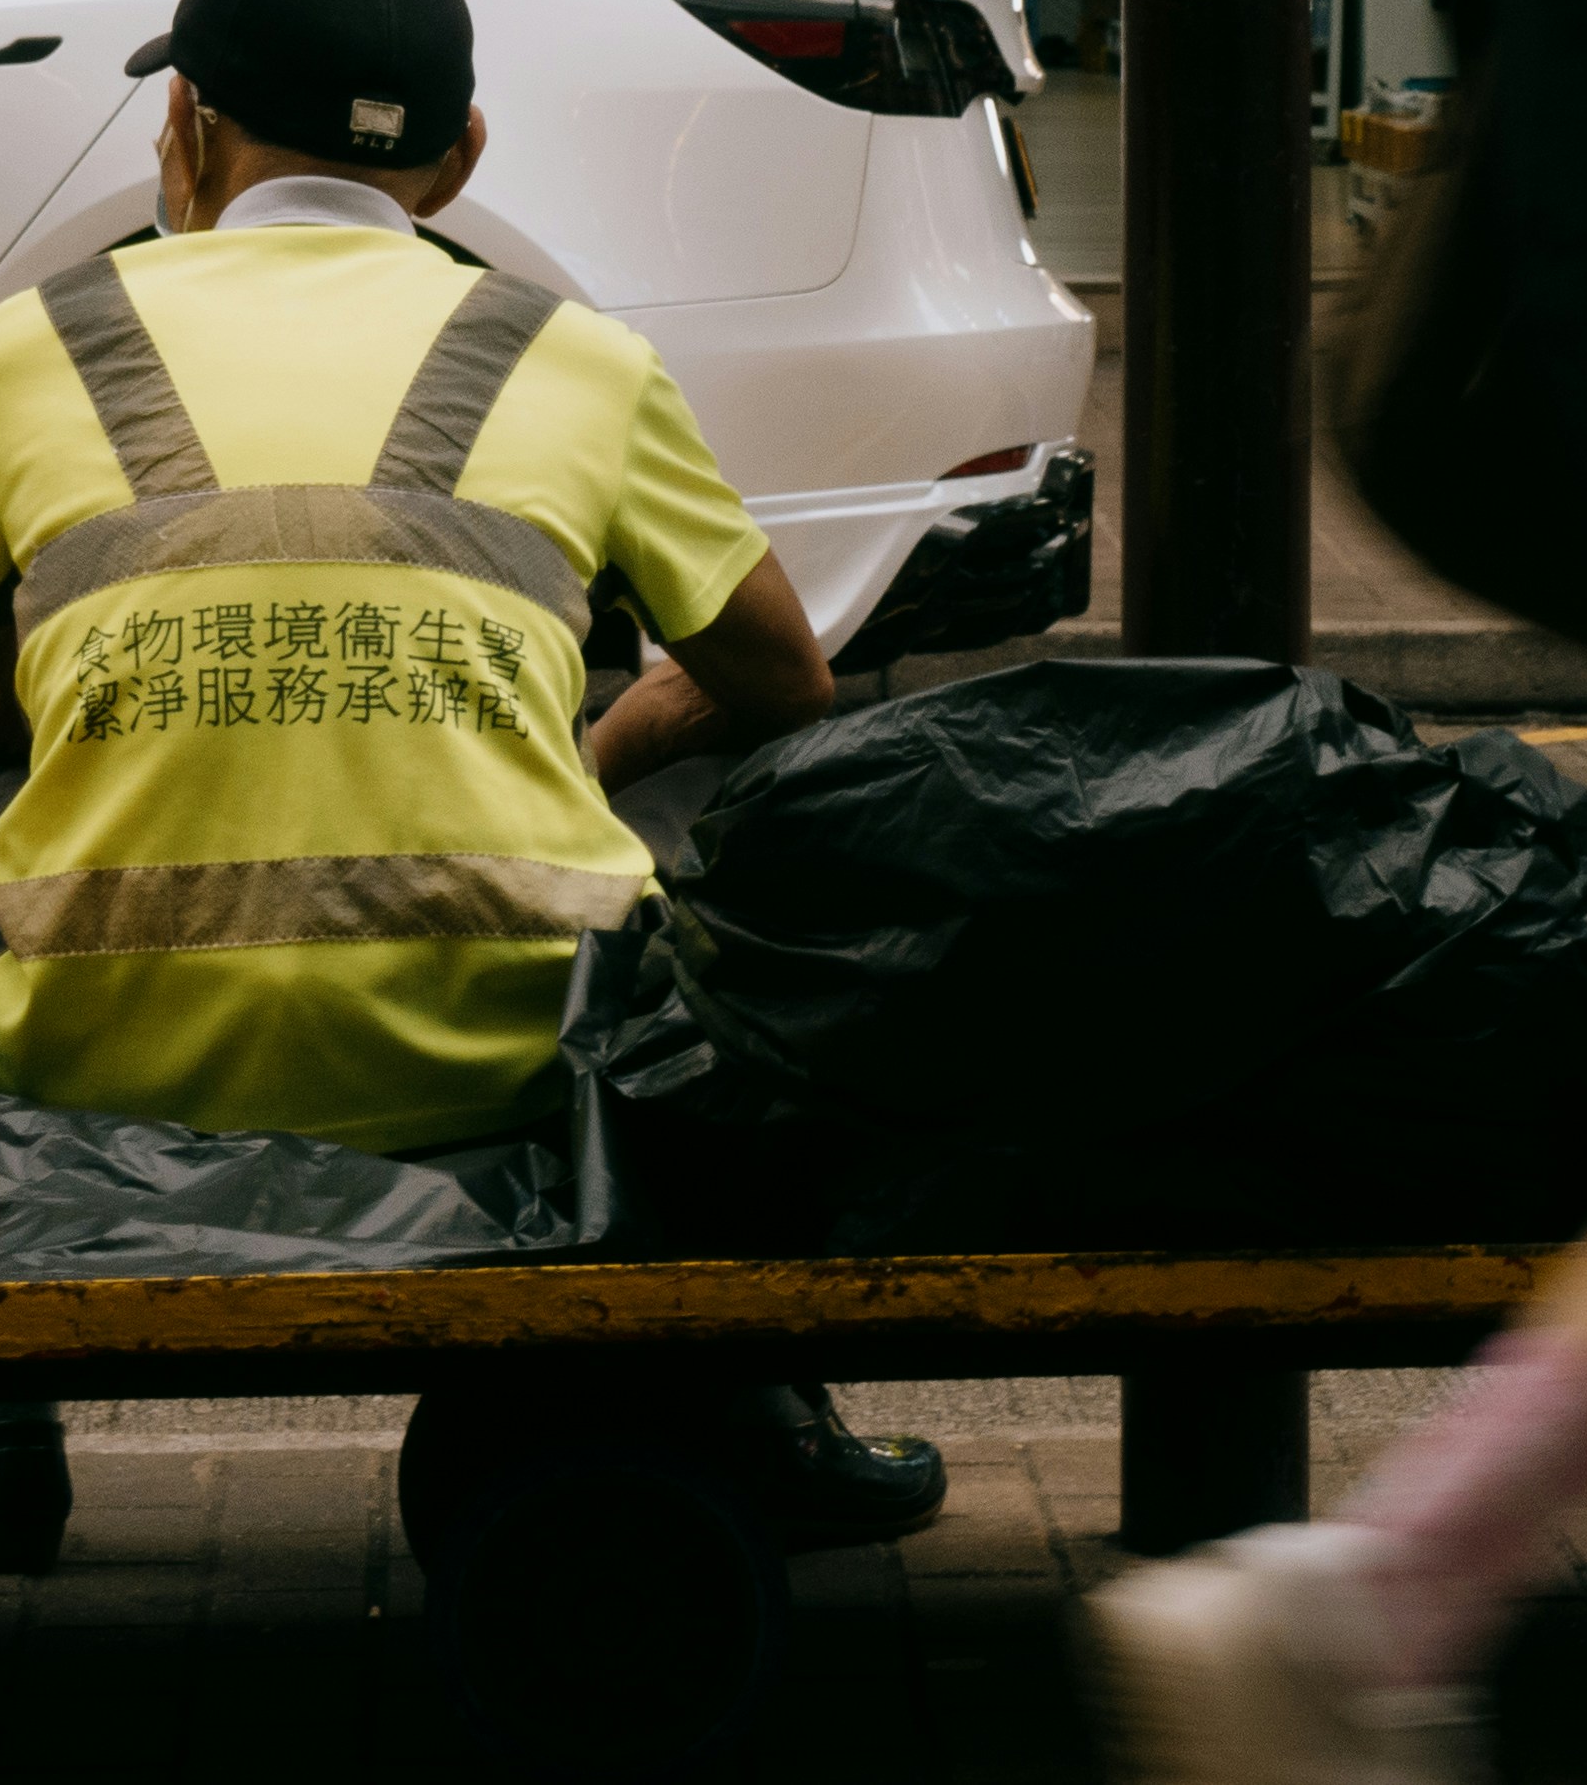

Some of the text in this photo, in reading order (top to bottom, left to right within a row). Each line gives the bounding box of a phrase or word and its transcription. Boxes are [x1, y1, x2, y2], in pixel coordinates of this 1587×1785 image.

[66, 663, 530, 743] 潔淨服務承辦商
